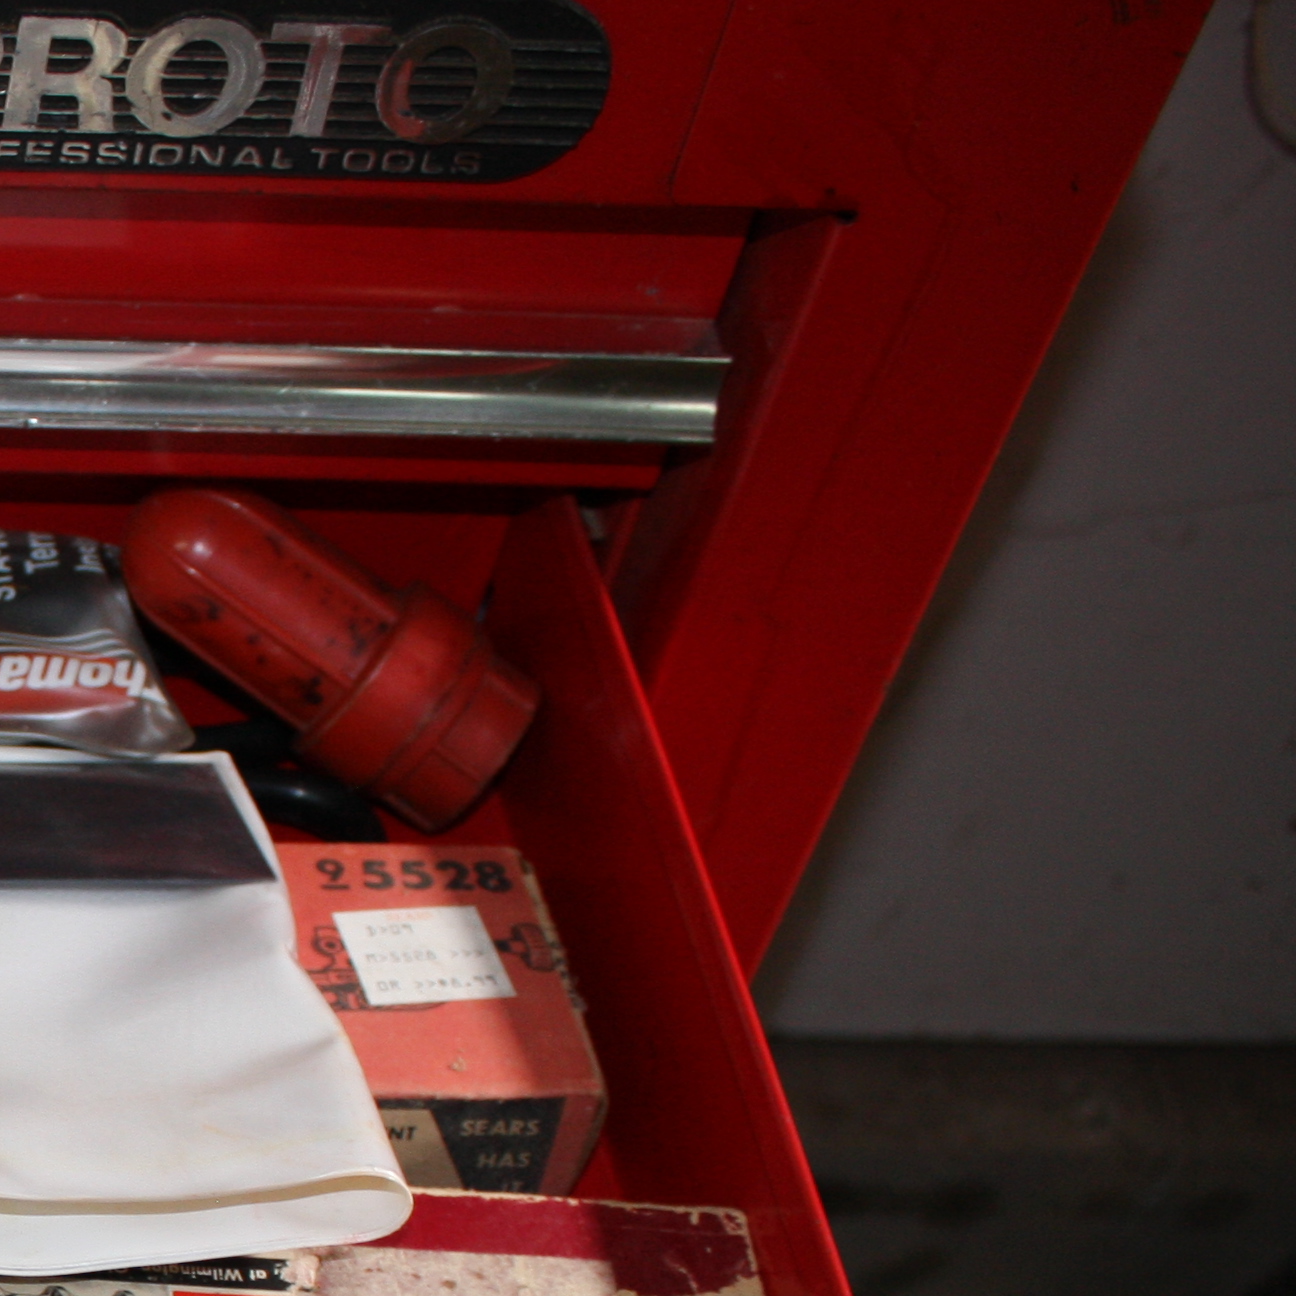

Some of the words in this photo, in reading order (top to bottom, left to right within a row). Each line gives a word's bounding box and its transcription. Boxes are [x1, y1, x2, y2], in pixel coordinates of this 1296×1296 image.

[316, 144, 482, 176] TOOLS
[315, 858, 349, 889] 9
[362, 859, 515, 892] 5528
[459, 1118, 540, 1138] SEARS
[477, 1151, 532, 1169] HAS
[249, 1268, 267, 1281] at
